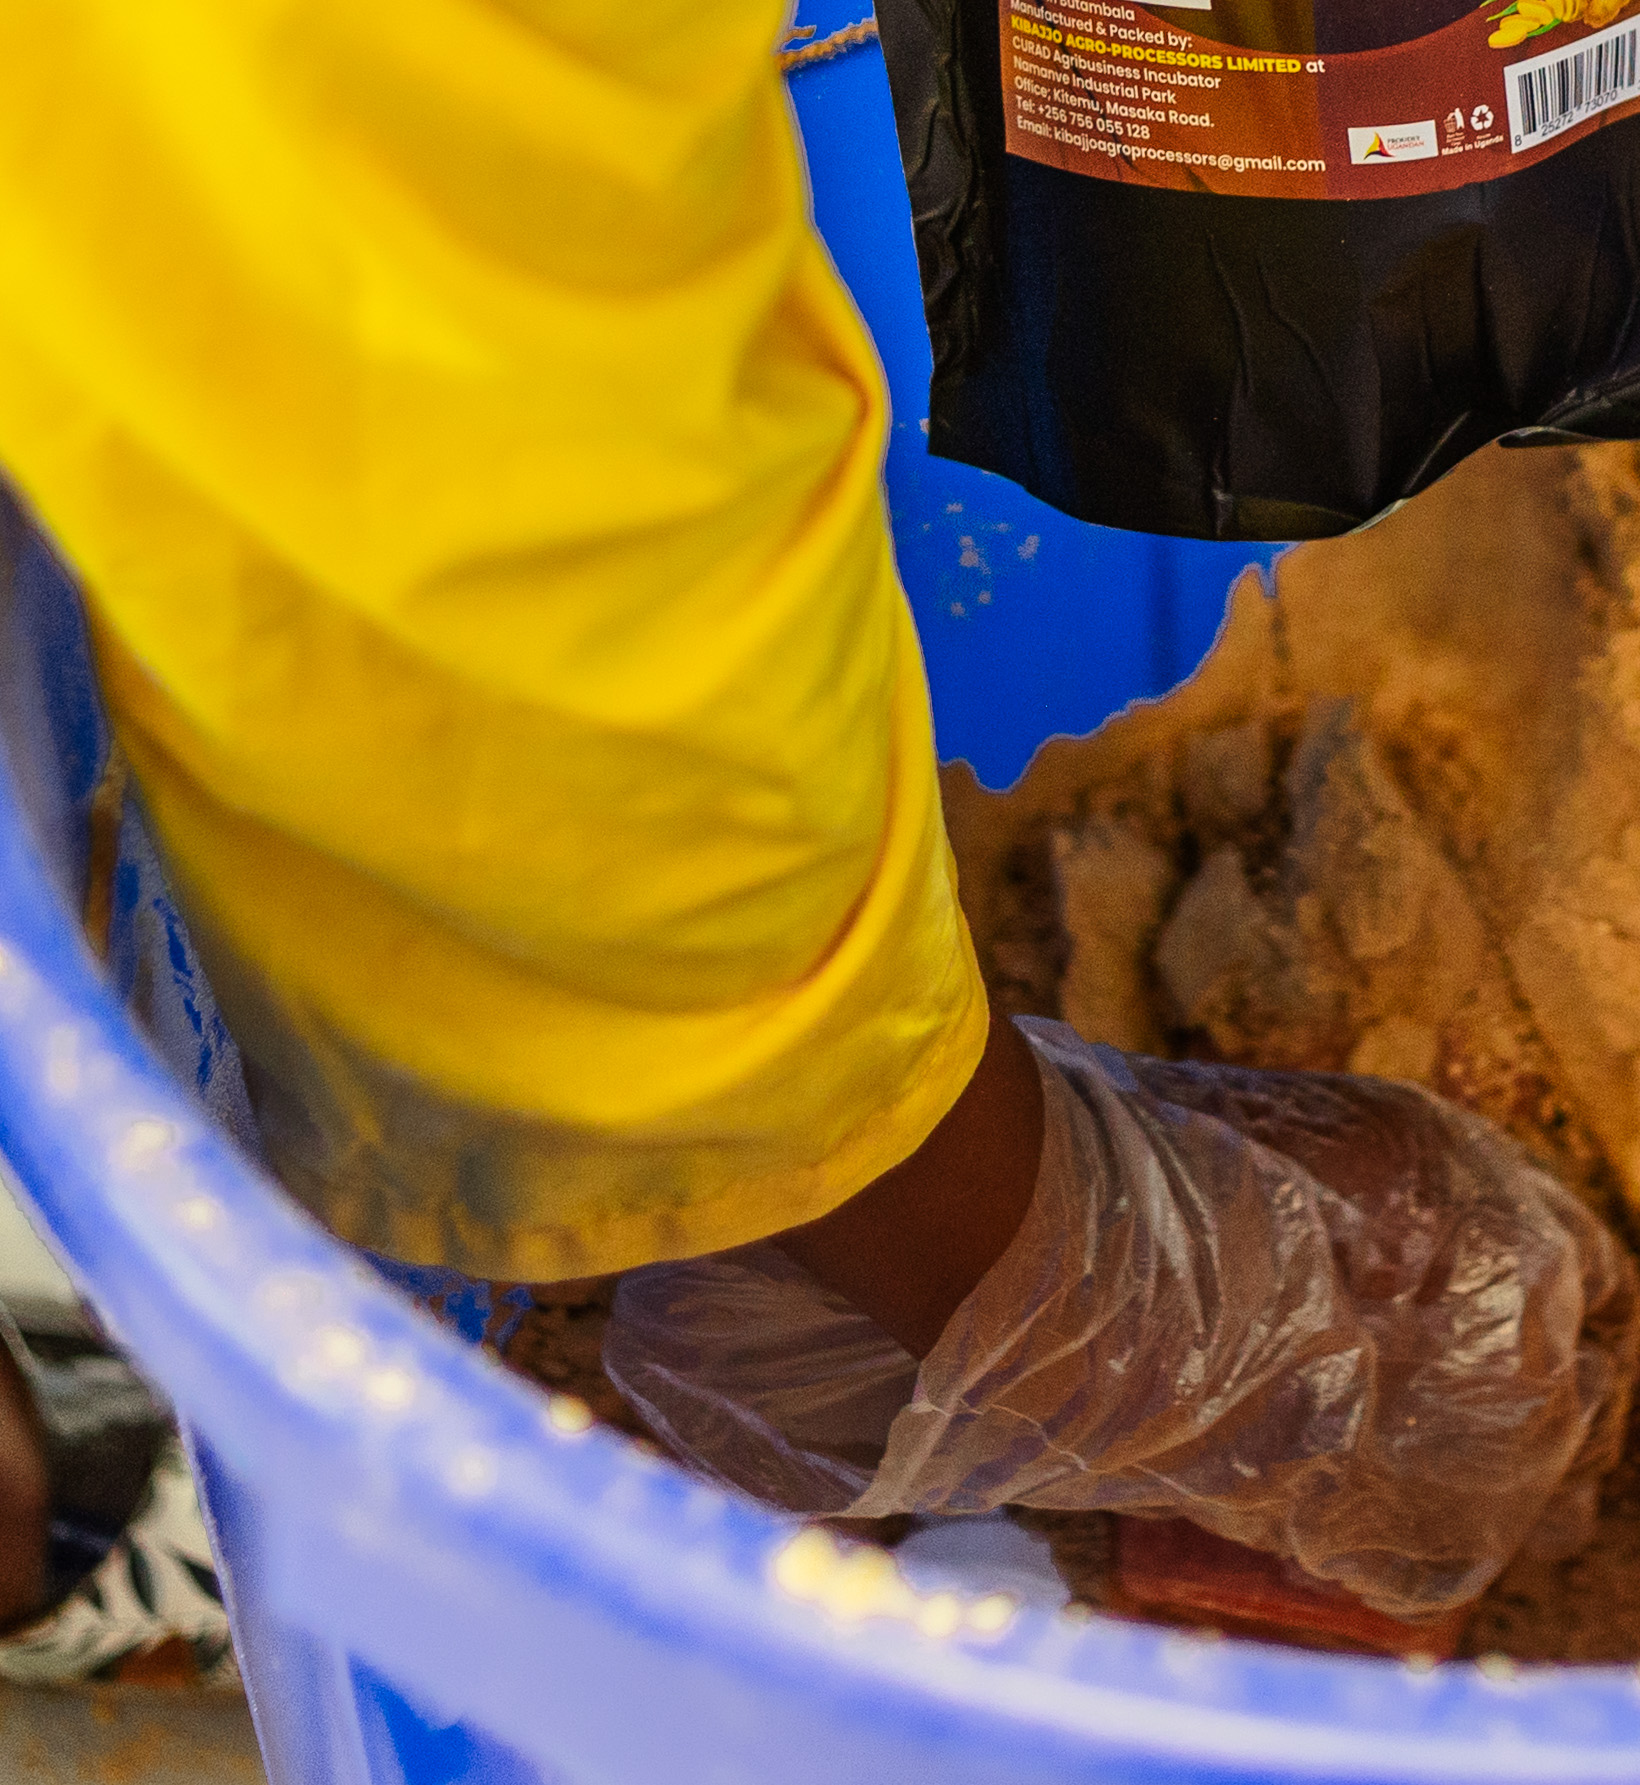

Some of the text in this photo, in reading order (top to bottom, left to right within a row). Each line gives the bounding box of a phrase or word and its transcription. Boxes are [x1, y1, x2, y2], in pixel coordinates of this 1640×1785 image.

[1011, 14, 1325, 73] KIBAJJO AGRO-PROCESSORS LIMITED at
[1096, 22, 1107, 36] &
[1109, 24, 1164, 44] Packed
[1168, 32, 1192, 51] by:
[1012, 35, 1221, 89] CURAD Agribusiness Incubator
[1013, 55, 1177, 105] Namanve Industrial Park
[1016, 96, 1150, 140] Tel: +256 756 055 128
[1053, 86, 1103, 114] Kitemu,
[1106, 100, 1166, 123] Masaka
[1169, 110, 1215, 127] Road.
[1514, 135, 1522, 147] 8
[1541, 112, 1574, 137] 25272
[1585, 90, 1617, 113] 73070
[1017, 115, 1326, 172] Email: kibajjoagroprocessors@gmail.com
[1441, 144, 1463, 156] Made
[1465, 142, 1474, 151] in
[1474, 135, 1504, 149] Uganda
